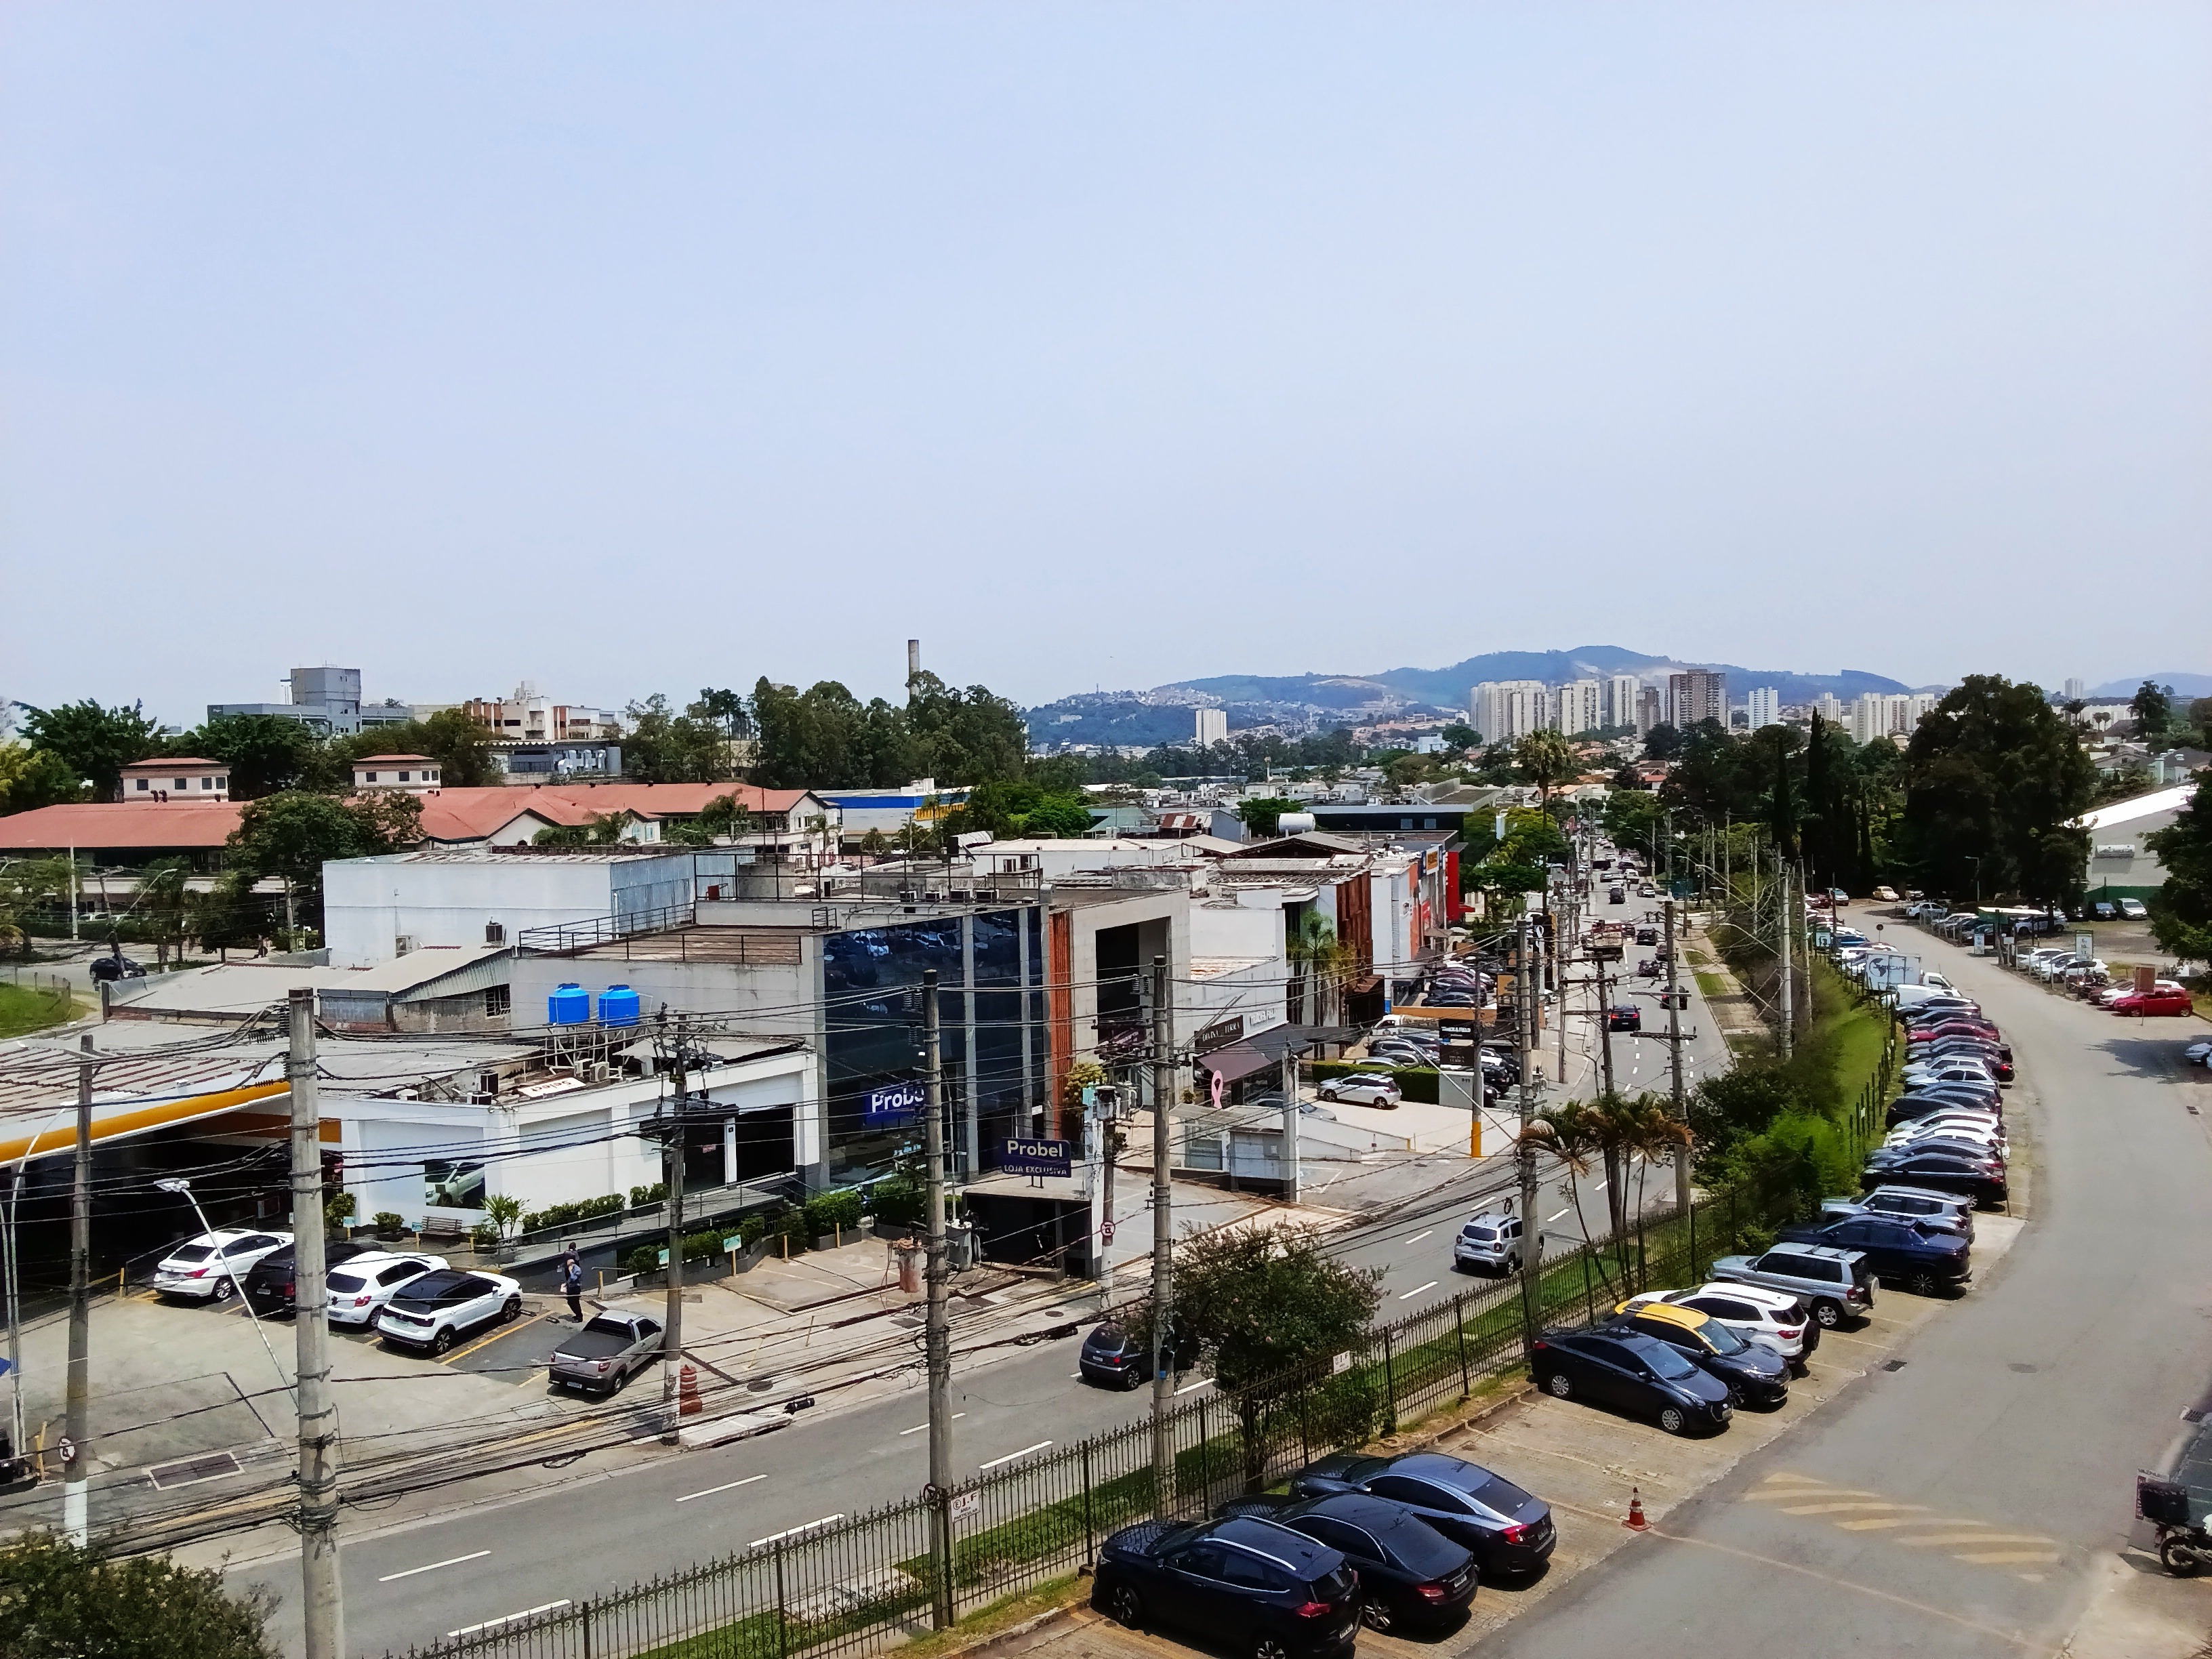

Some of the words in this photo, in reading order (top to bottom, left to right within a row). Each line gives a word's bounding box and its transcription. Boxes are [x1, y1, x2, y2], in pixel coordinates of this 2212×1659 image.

[1007, 1140, 1063, 1158] Probel
[1004, 1164, 1023, 1173] LOJA
[1025, 1166, 1067, 1175] EXCLUSIVA
